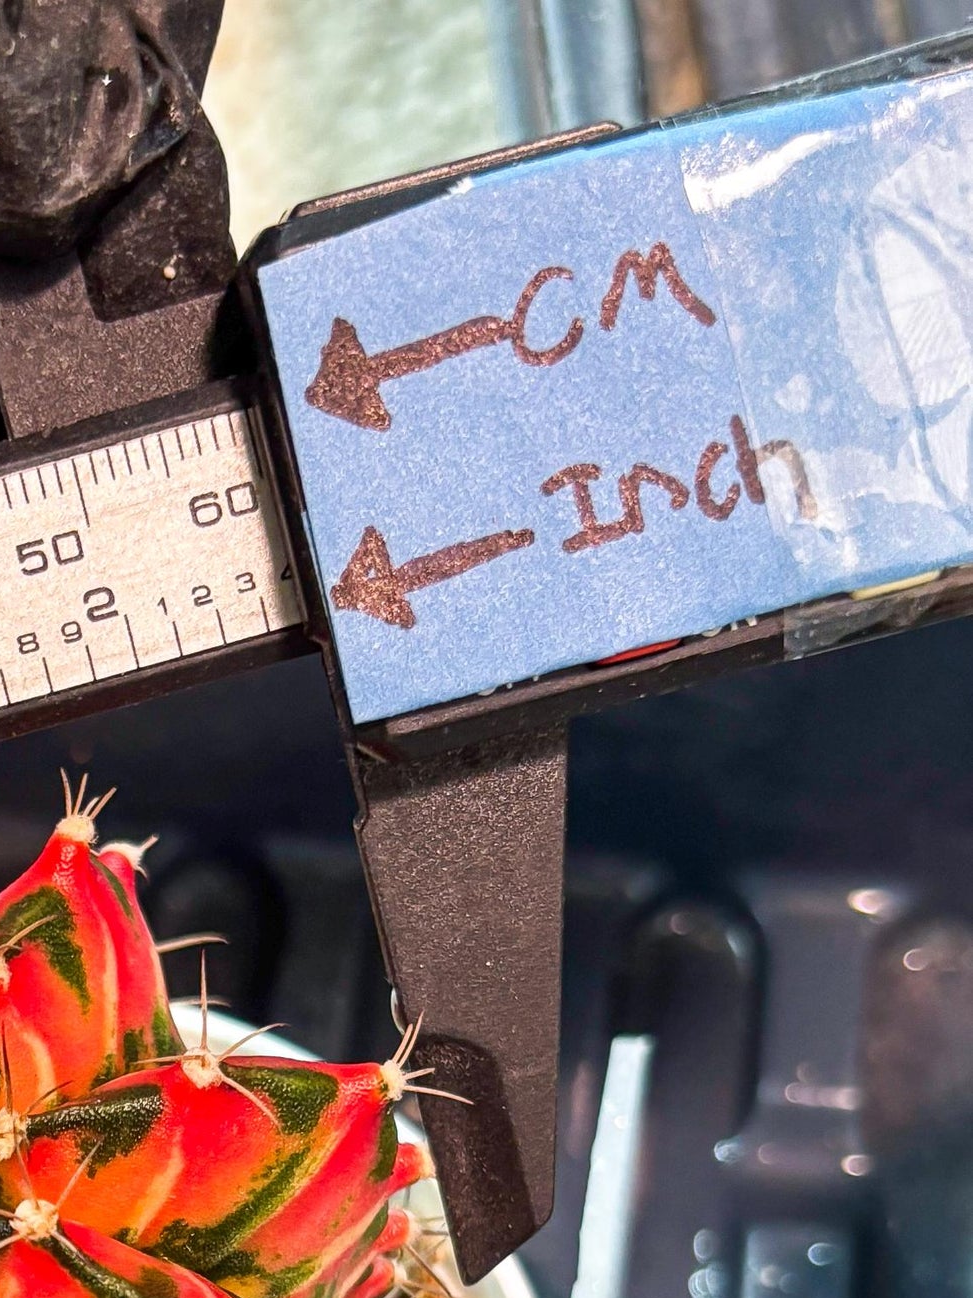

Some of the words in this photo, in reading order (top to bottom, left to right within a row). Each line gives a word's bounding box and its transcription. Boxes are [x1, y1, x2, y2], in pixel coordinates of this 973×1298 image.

[15, 529, 85, 577] 50
[188, 481, 259, 529] 60
[540, 414, 818, 553] Inch
[16, 632, 40, 655] 8
[61, 621, 82, 644] 9
[82, 586, 119, 622] 2
[156, 597, 168, 616] 1
[191, 584, 213, 607] 2
[235, 572, 256, 594] 3
